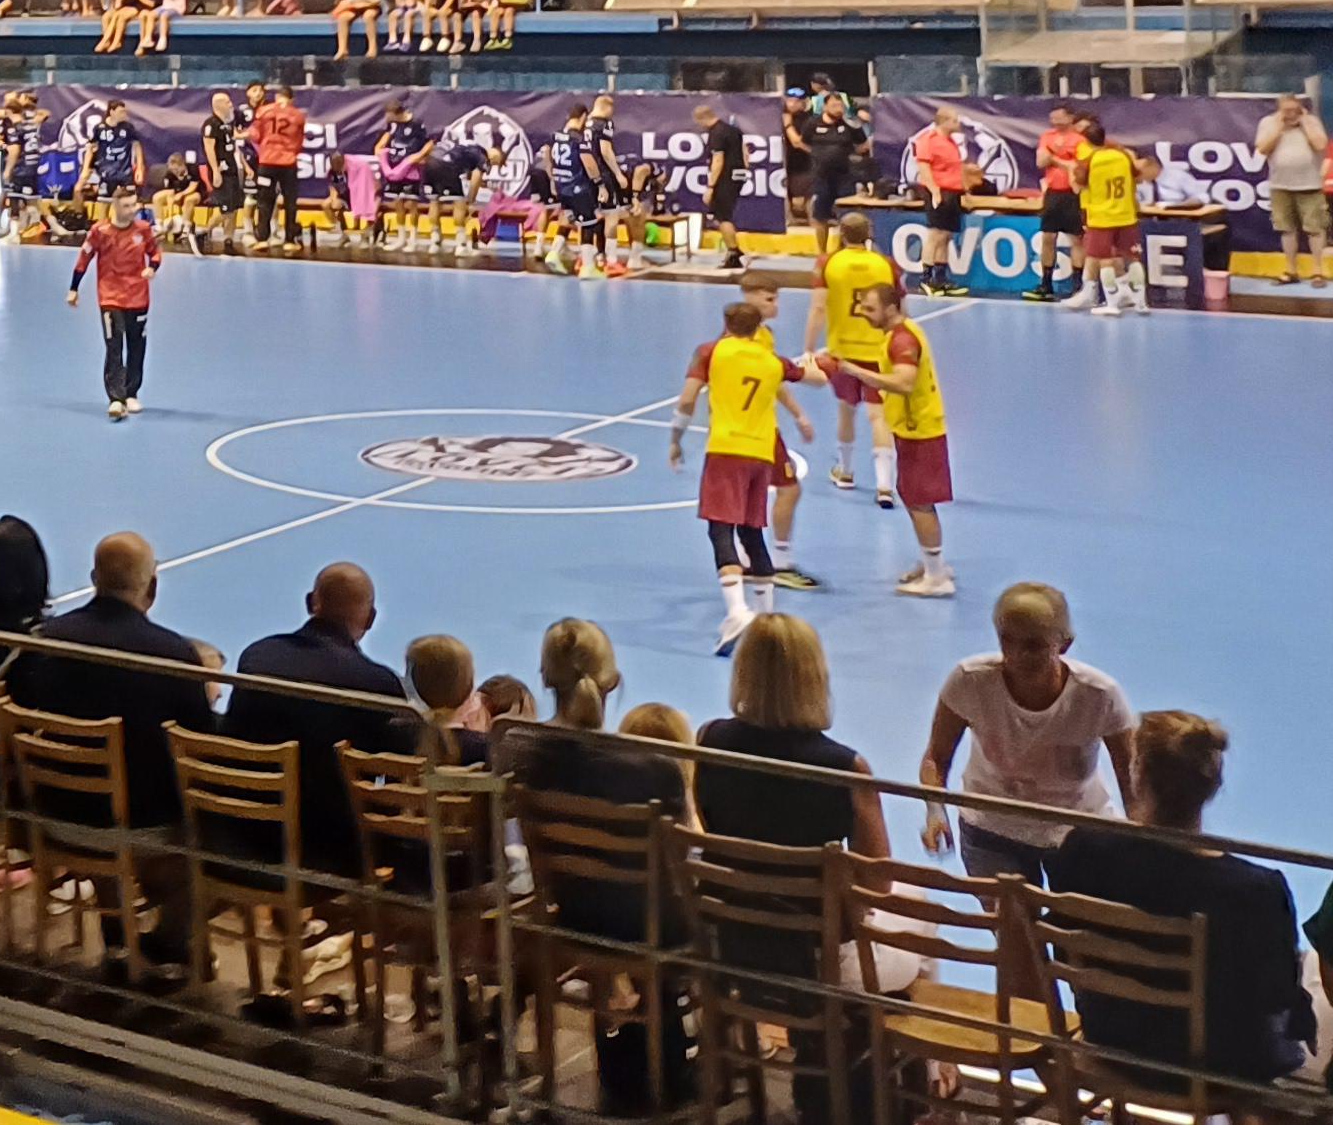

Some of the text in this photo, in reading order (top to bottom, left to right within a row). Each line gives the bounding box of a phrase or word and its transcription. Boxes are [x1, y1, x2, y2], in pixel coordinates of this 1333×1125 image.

[270, 117, 290, 135] 12
[552, 142, 572, 166] 42
[642, 132, 783, 163] LOCI
[1106, 176, 1125, 199] 18
[741, 376, 761, 411] 7
